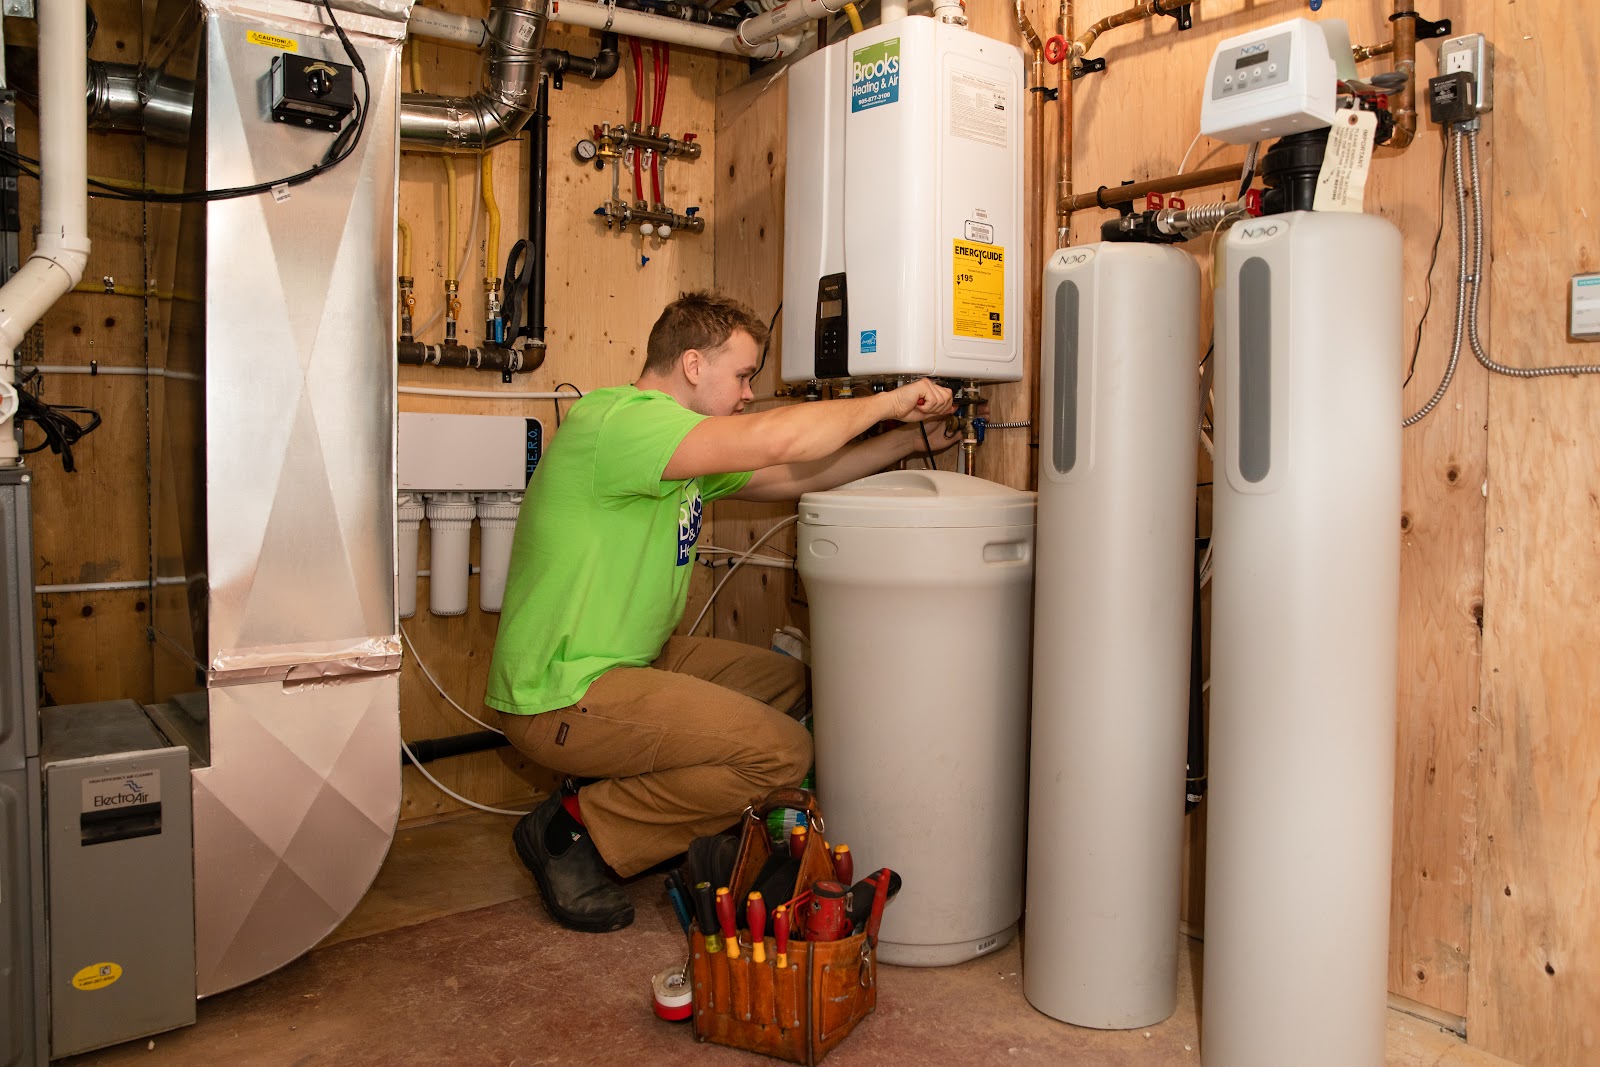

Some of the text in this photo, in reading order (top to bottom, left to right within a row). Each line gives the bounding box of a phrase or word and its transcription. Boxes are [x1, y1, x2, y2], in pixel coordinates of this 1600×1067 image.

[258, 34, 286, 44] CAUTION!
[1240, 43, 1266, 56] NOVO
[853, 52, 898, 84] Brooks
[852, 74, 898, 97] Heating & Air
[1241, 226, 1278, 240] NOVO
[955, 246, 1002, 262] ENERGYGUIDE
[1058, 254, 1086, 266] NOVO
[956, 274, 974, 282] $195
[526, 428, 538, 472] H.E.R.O.
[94, 792, 149, 807] ElectroAir
